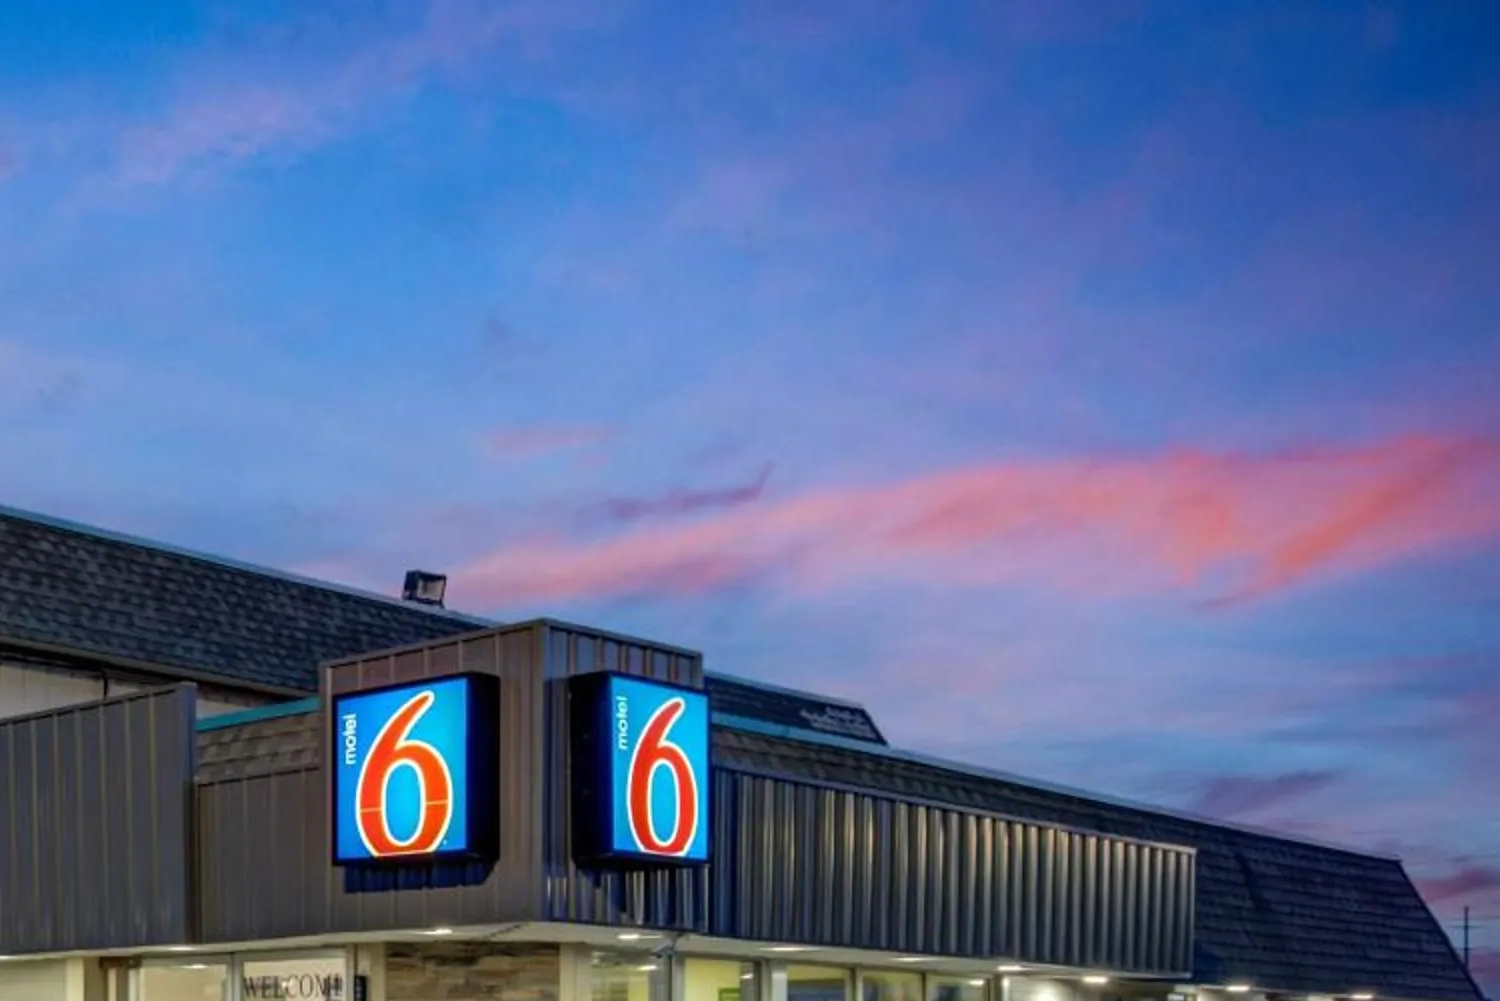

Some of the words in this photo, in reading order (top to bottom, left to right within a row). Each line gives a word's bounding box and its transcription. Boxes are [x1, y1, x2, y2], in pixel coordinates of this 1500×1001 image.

[343, 713, 357, 765] motel
[355, 690, 453, 858] 6
[616, 696, 629, 750] motel
[626, 697, 698, 857] 6
